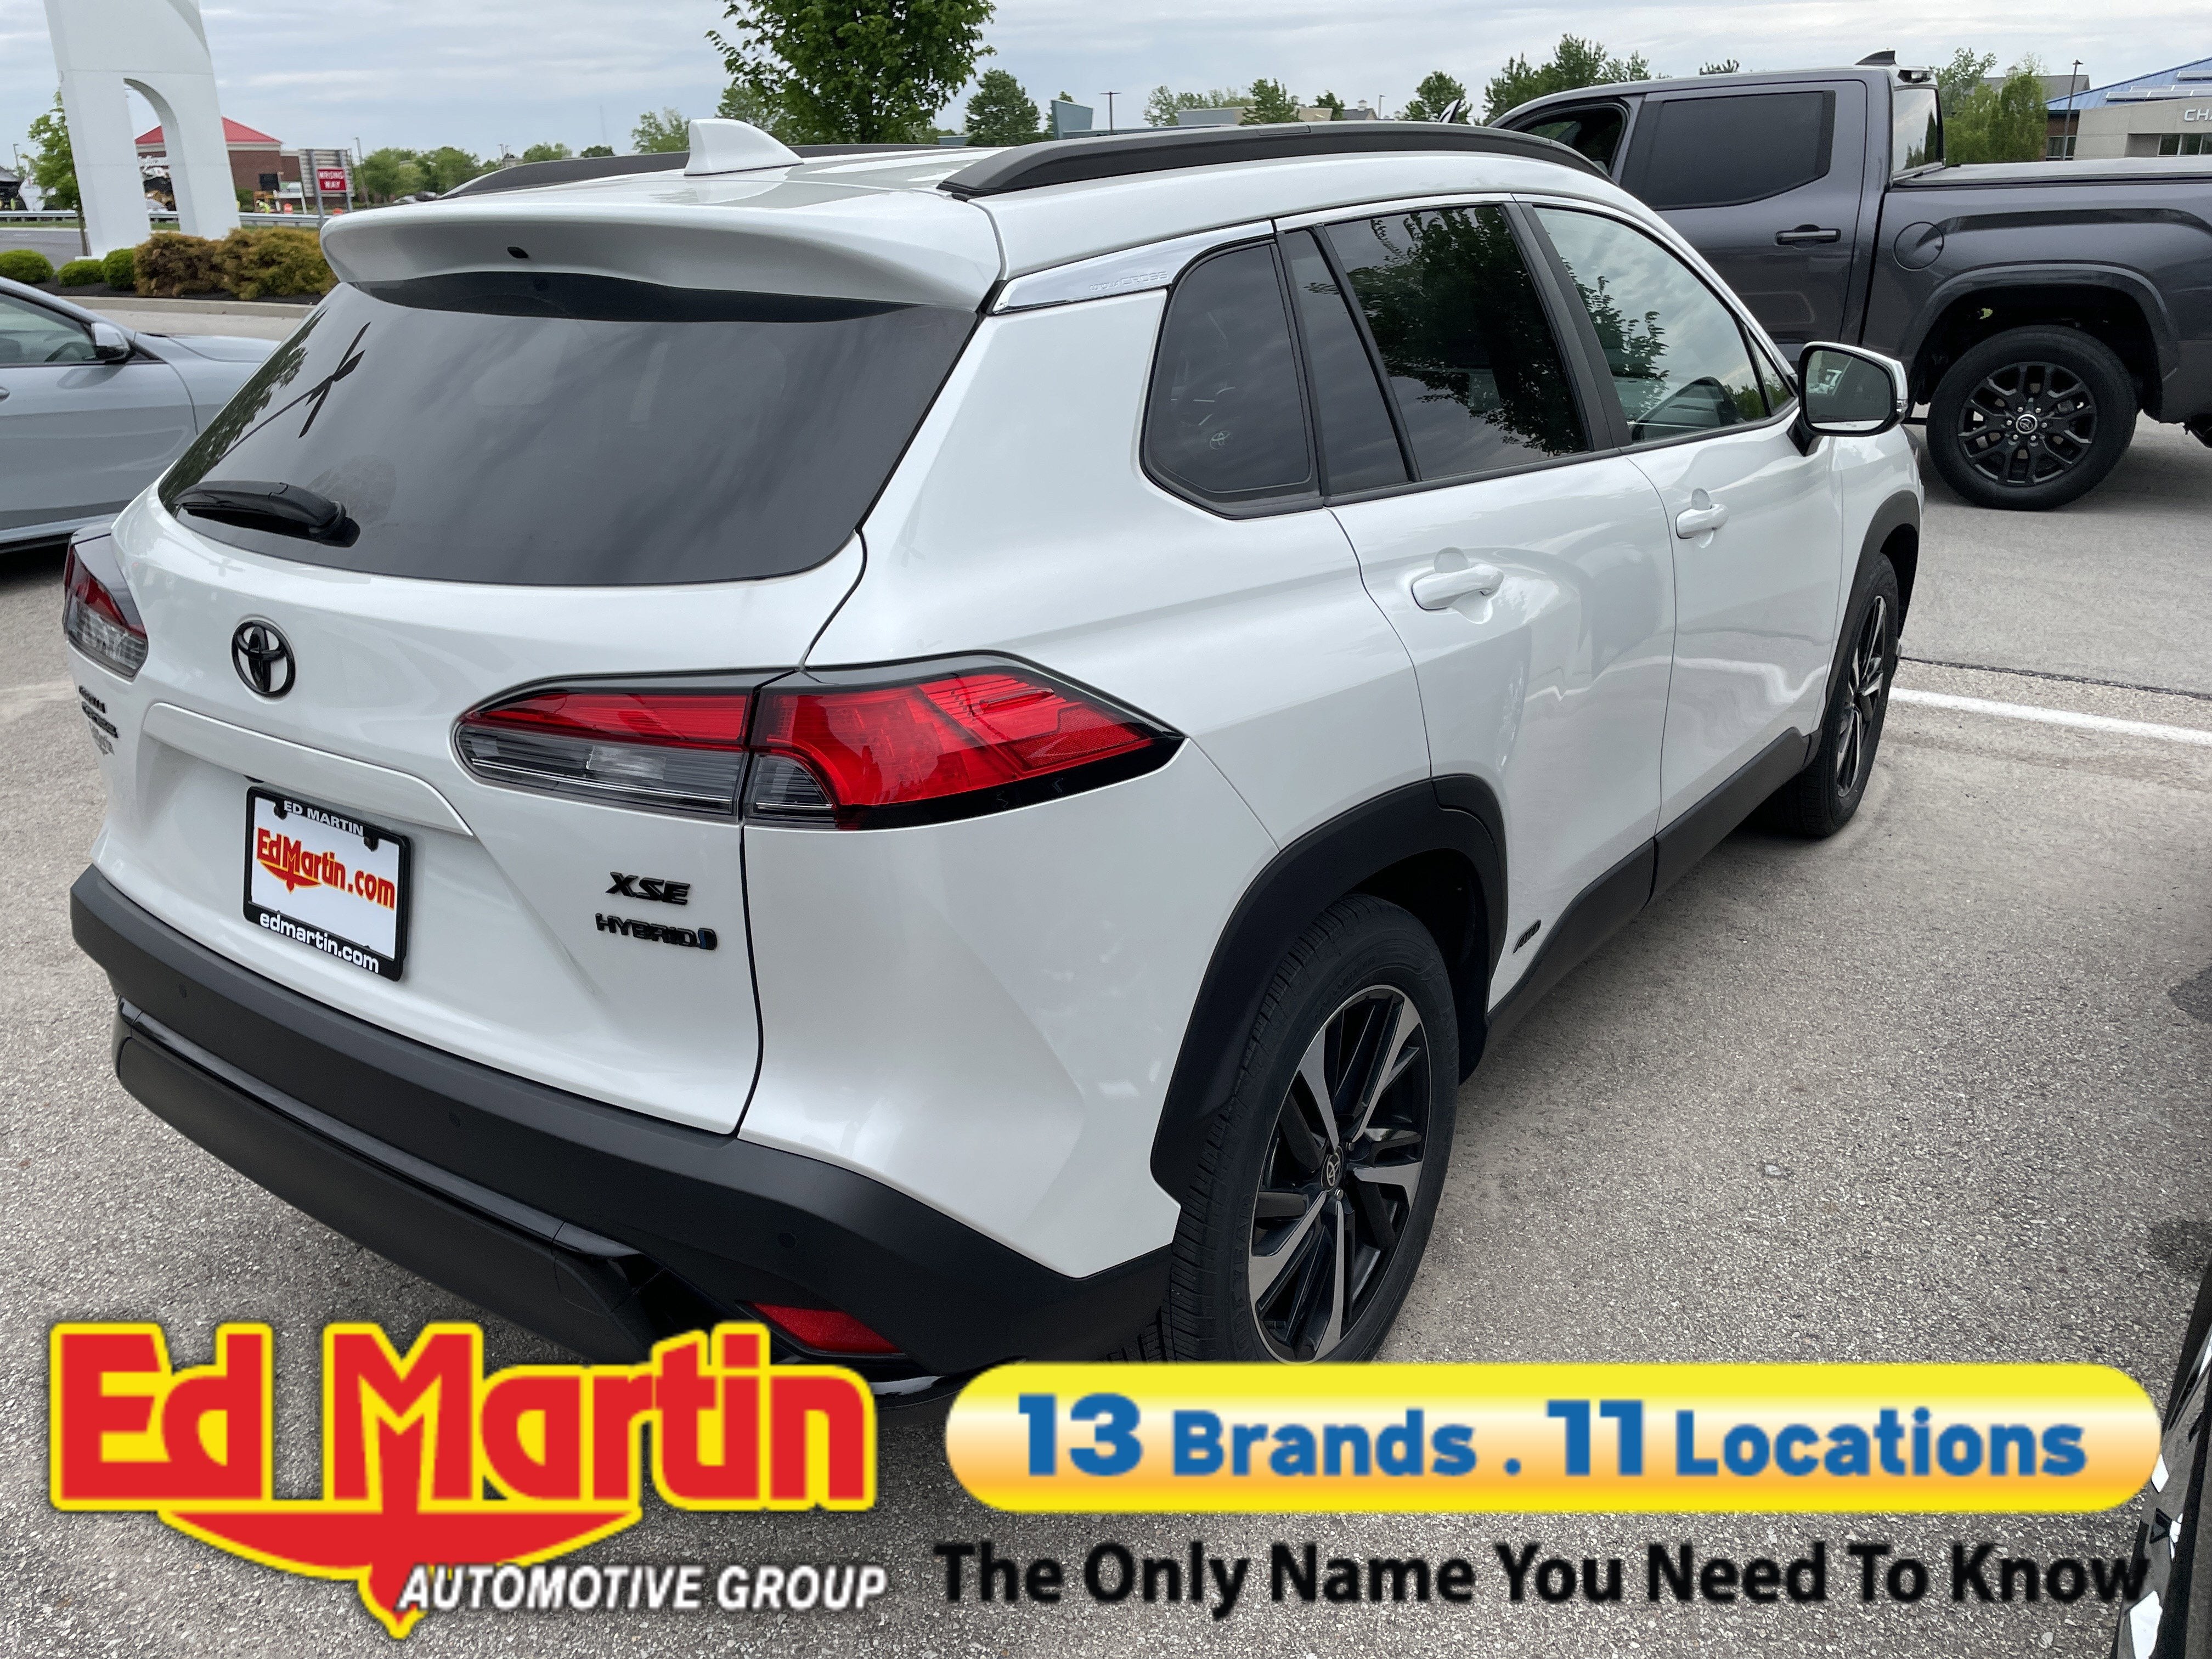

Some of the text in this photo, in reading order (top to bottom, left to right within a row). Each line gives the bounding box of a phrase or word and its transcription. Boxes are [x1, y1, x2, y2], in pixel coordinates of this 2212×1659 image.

[2184, 109, 2212, 121] CH
[1120, 271, 1169, 285] CROSS
[284, 800, 364, 836] ED MARTIN
[605, 871, 691, 905] XSE
[259, 912, 379, 973] edmartin.com
[595, 912, 697, 947] HYBRID
